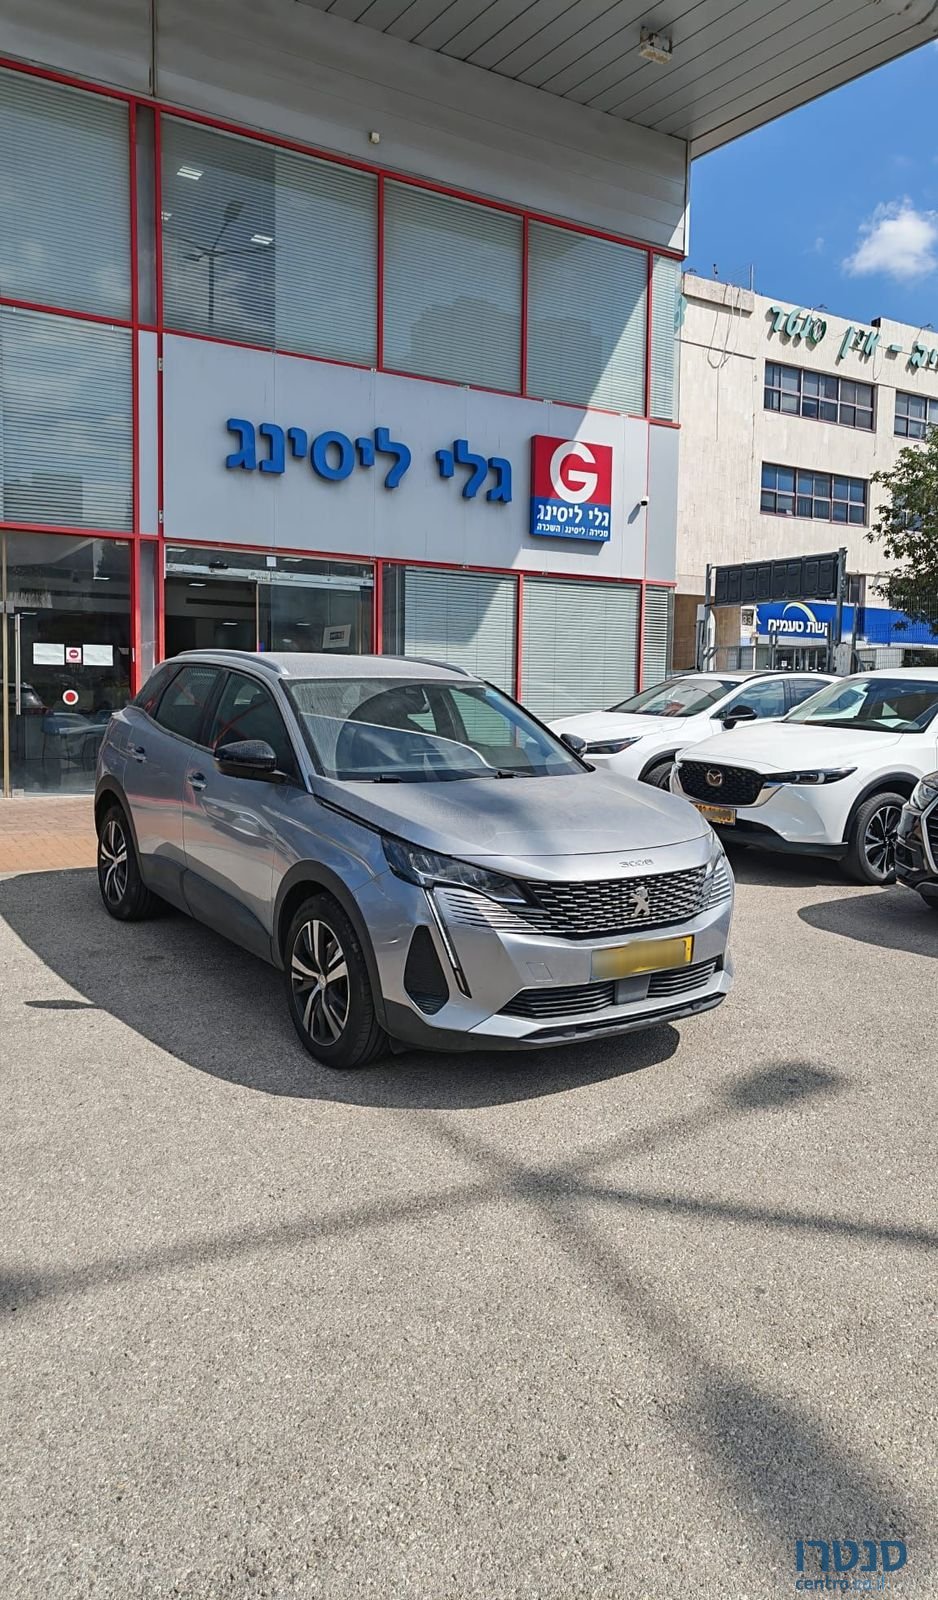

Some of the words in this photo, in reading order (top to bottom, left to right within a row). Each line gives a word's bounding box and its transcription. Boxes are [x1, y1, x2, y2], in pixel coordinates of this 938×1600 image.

[770, 305, 827, 344] סנטר
[225, 418, 412, 489] ליסינג
[435, 439, 512, 503] גלי
[549, 440, 598, 504] G
[536, 504, 583, 523] ליסינג
[536, 522, 561, 533] השכרה
[588, 507, 610, 527] גלי
[564, 525, 585, 535] ליסינג
